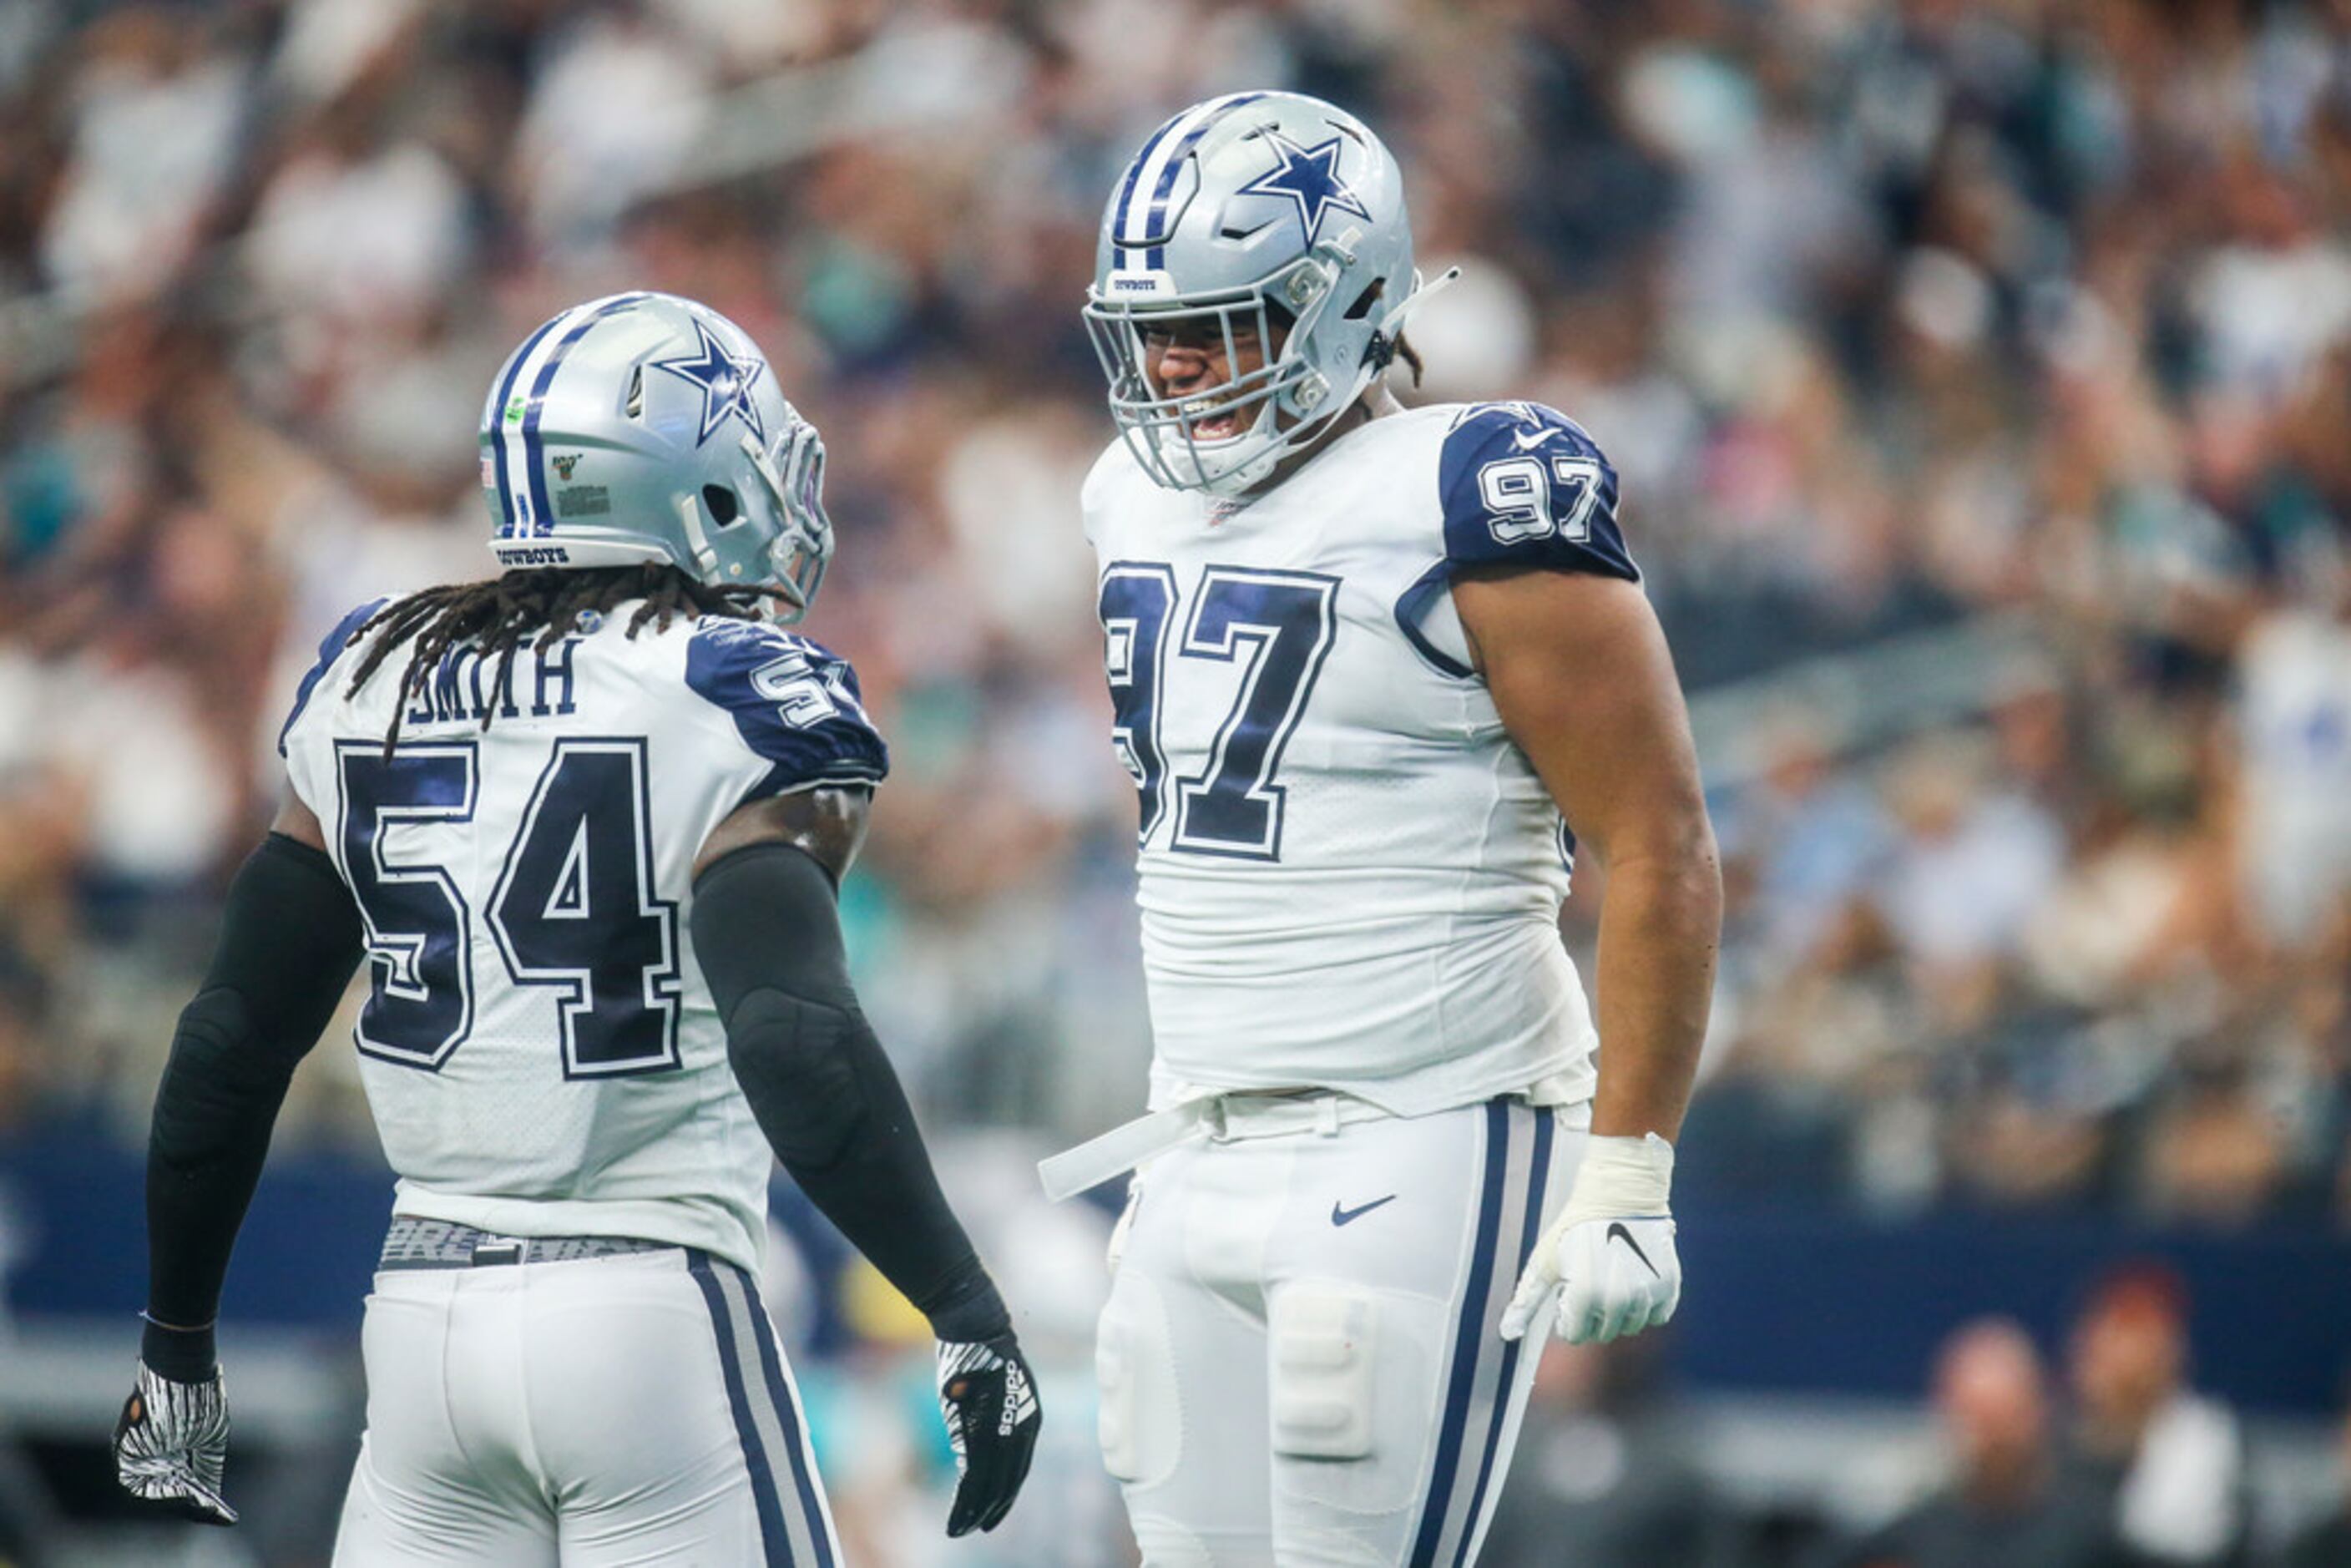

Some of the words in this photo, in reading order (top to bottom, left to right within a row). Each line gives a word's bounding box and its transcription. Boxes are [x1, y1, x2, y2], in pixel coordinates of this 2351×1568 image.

[1476, 456, 1603, 546] 97
[1098, 560, 1343, 863] 97
[333, 736, 683, 1082] 54
[998, 1358, 1019, 1436] adidas
